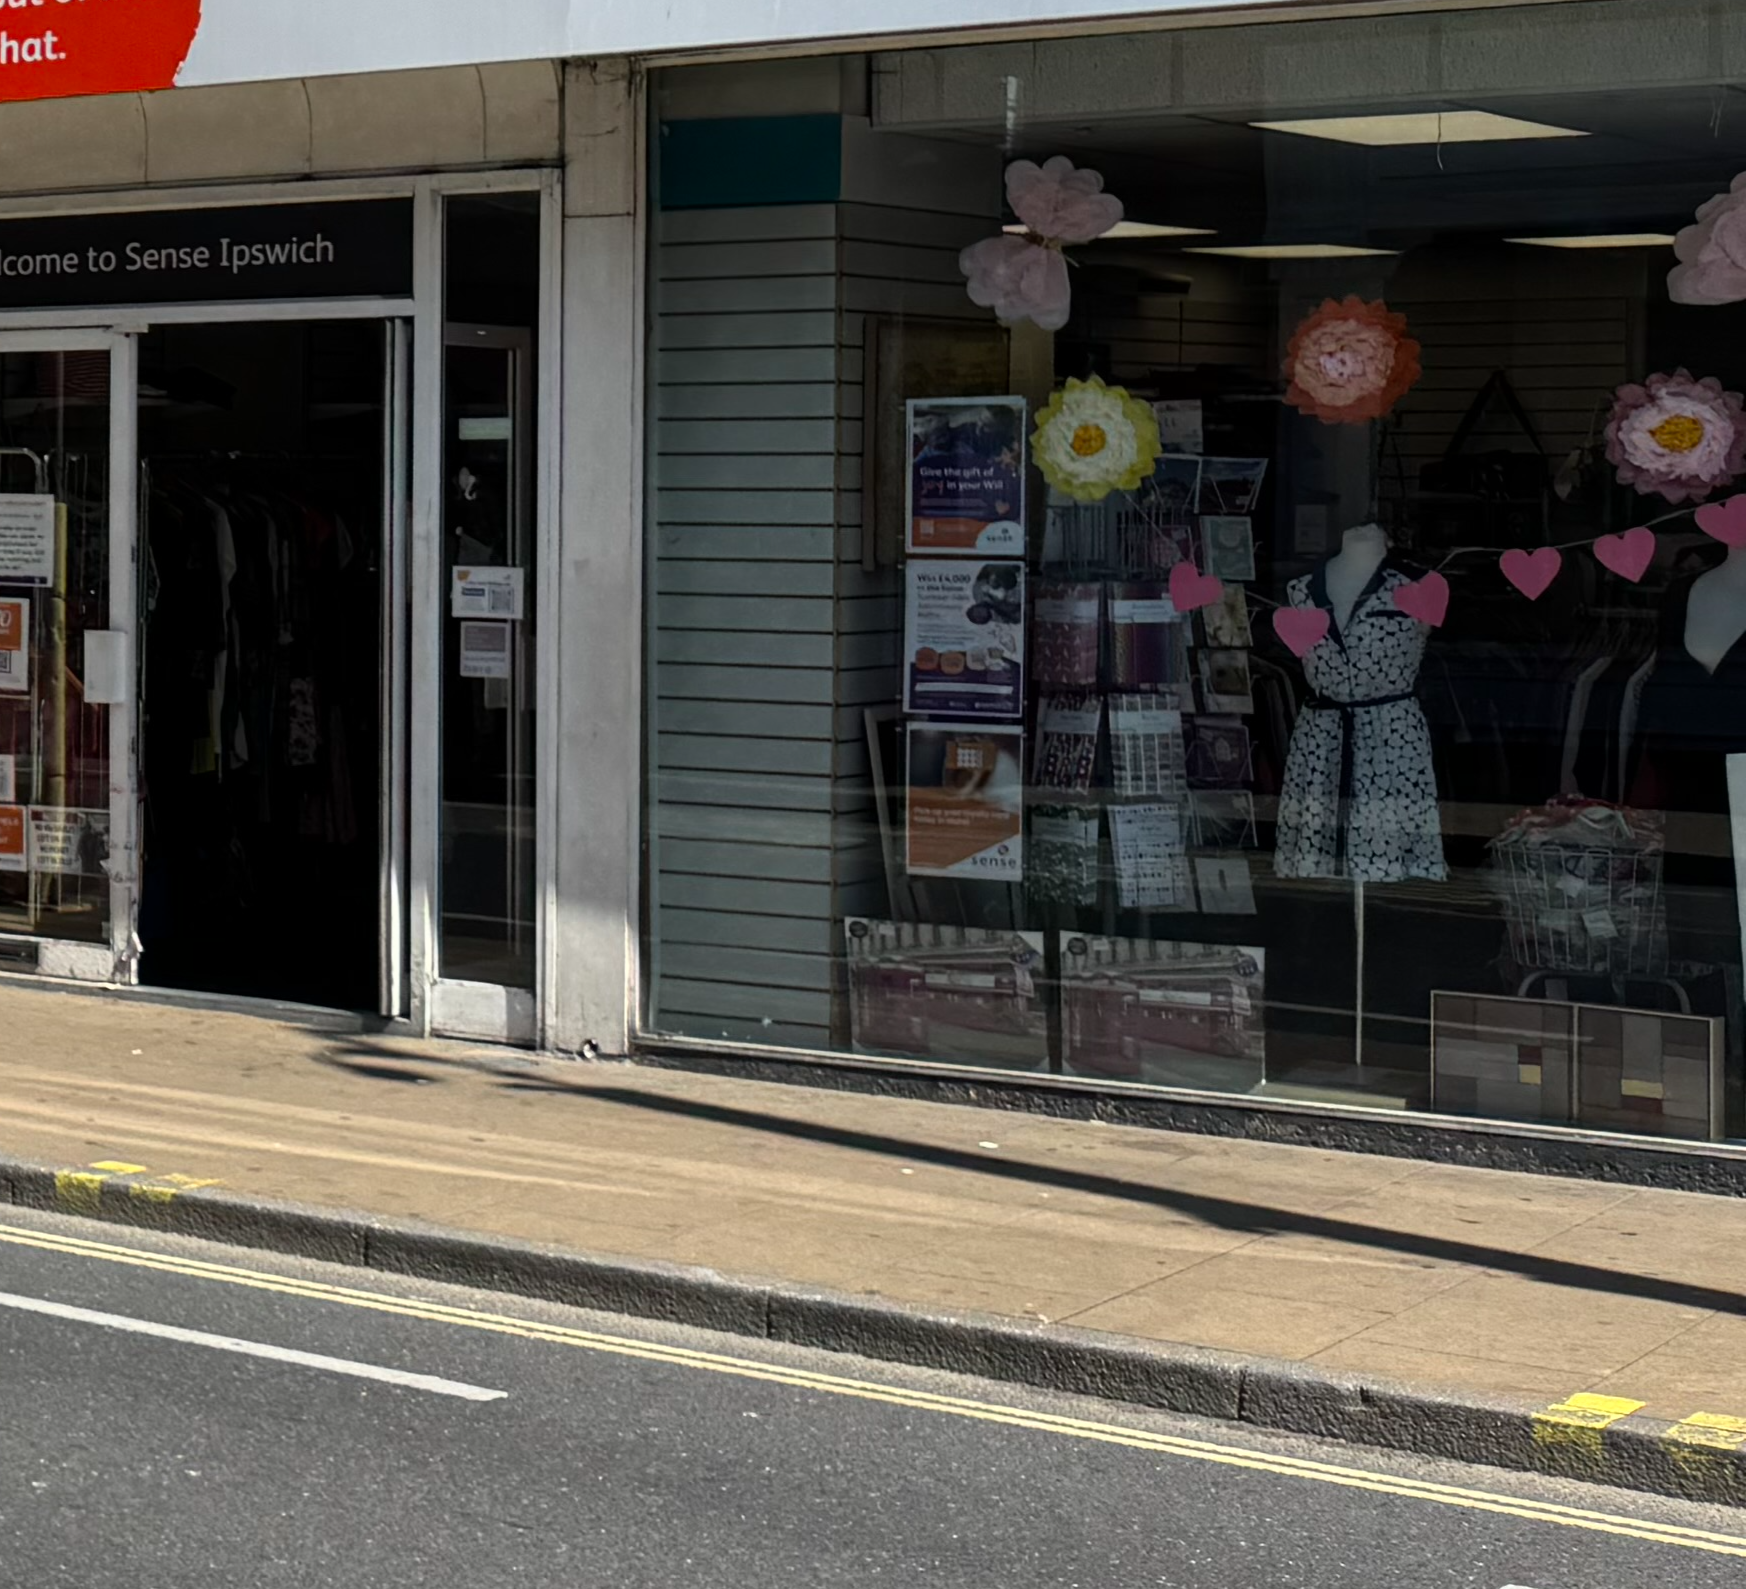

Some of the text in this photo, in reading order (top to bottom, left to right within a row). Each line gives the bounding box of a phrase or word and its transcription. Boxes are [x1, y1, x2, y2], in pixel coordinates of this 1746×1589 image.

[86, 245, 118, 274] to
[124, 240, 211, 271] Sense
[220, 234, 336, 268] Ipswich
[970, 855, 1017, 869] sense
